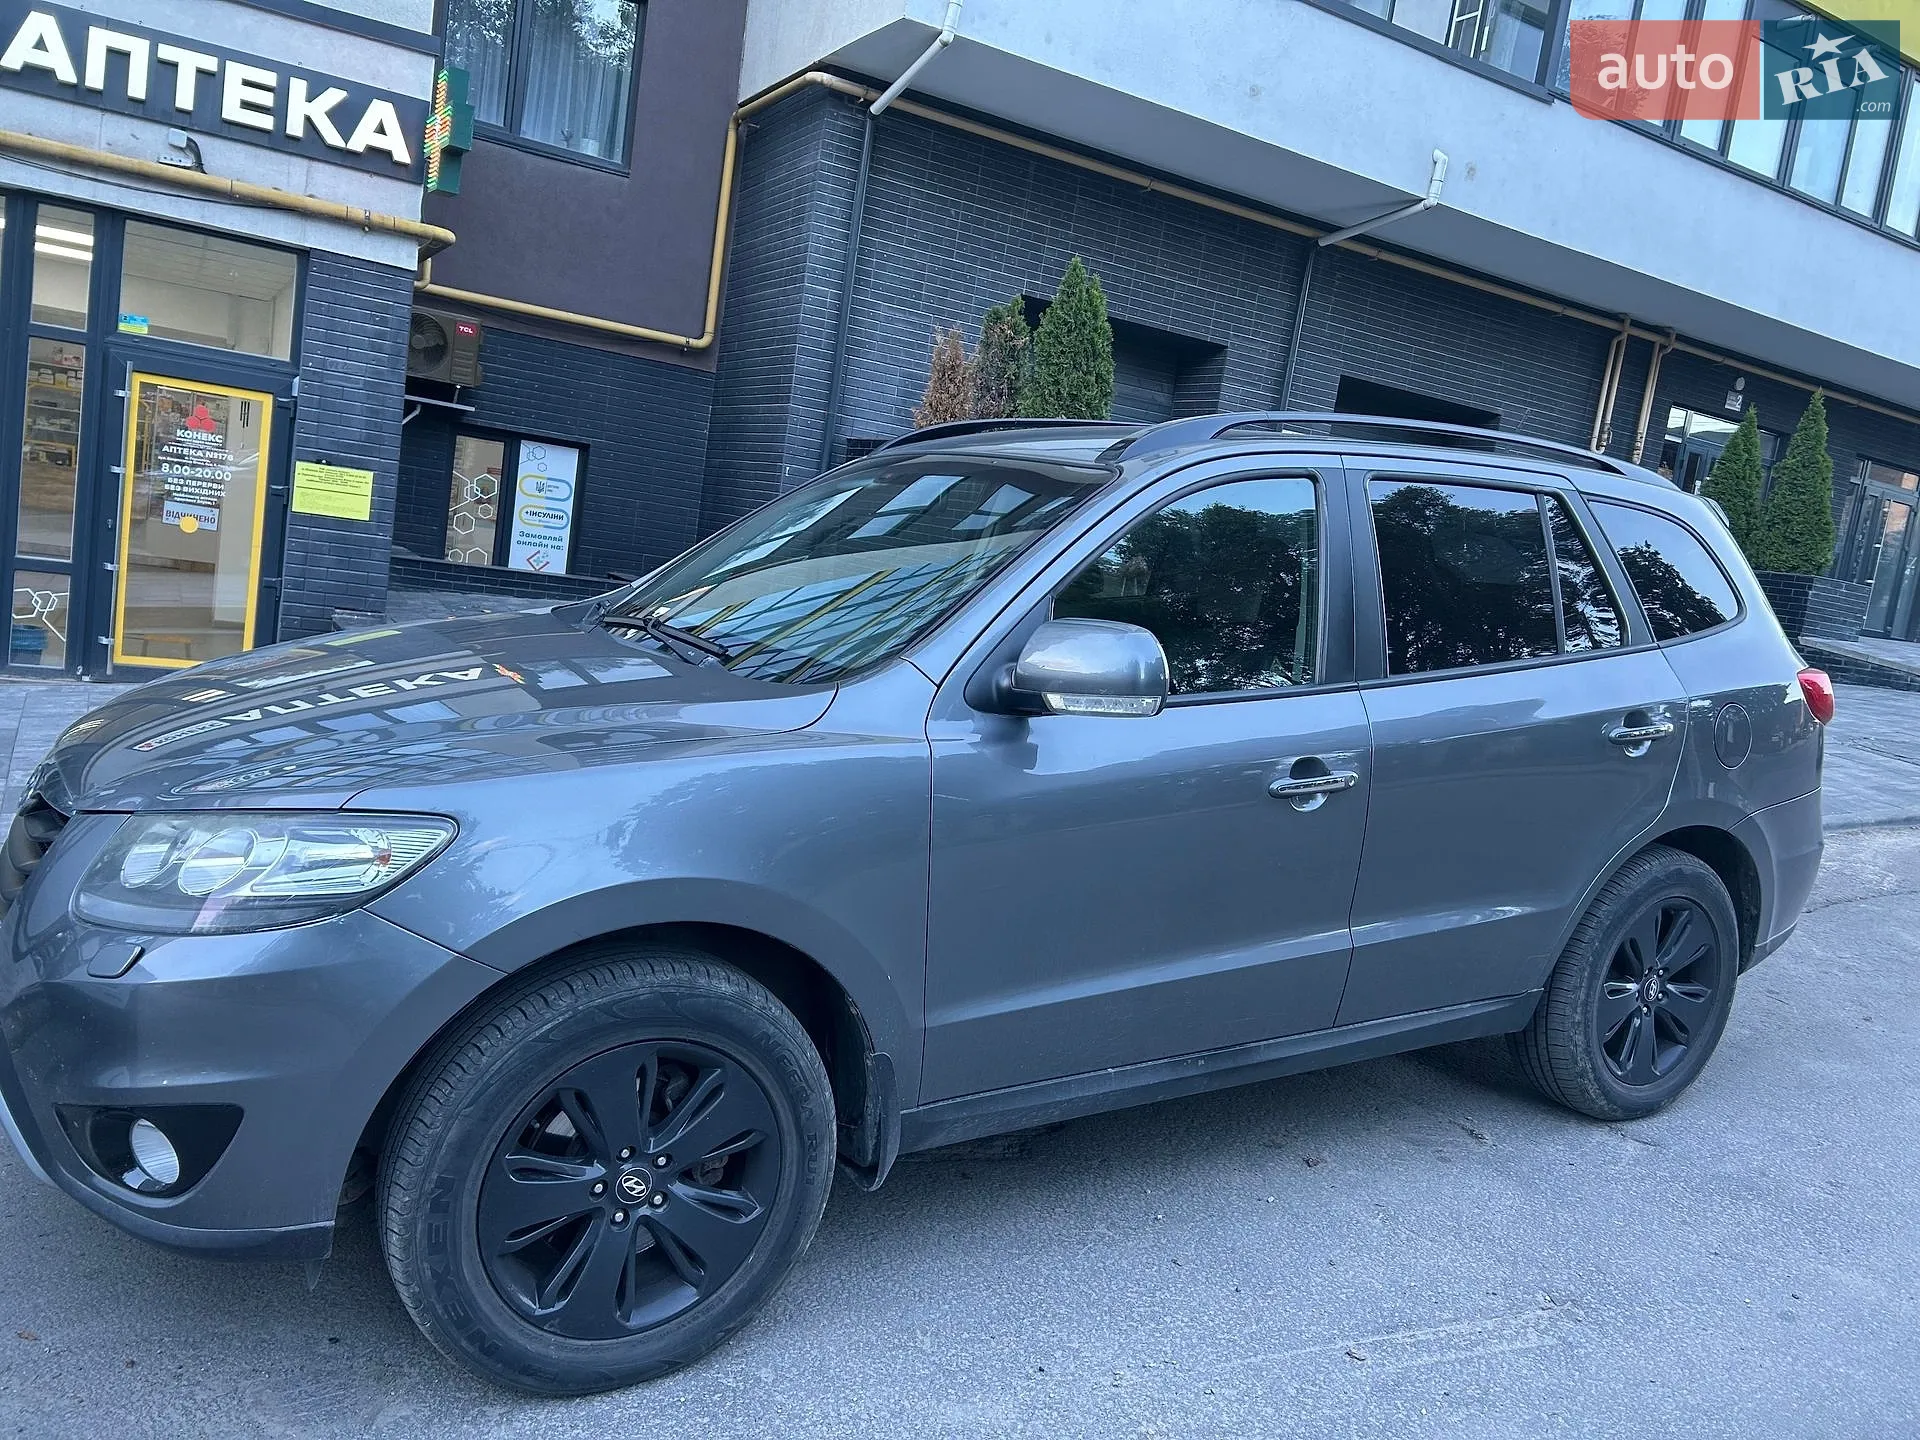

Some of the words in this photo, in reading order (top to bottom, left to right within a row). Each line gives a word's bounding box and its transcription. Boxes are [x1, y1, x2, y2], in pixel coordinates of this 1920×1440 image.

[0, 10, 412, 165] АПТЕКА
[459, 325, 473, 334] TCL
[1736, 394, 1743, 408] 2
[176, 429, 223, 443] КОНЕКС
[162, 445, 204, 458] АПТЕКА
[161, 463, 232, 481] 8.00-20.00
[167, 477, 184, 485] БЕЗ
[185, 479, 225, 490] ПЕРЕРВИ
[519, 530, 563, 543] Замовляй
[516, 539, 549, 549] онлайн
